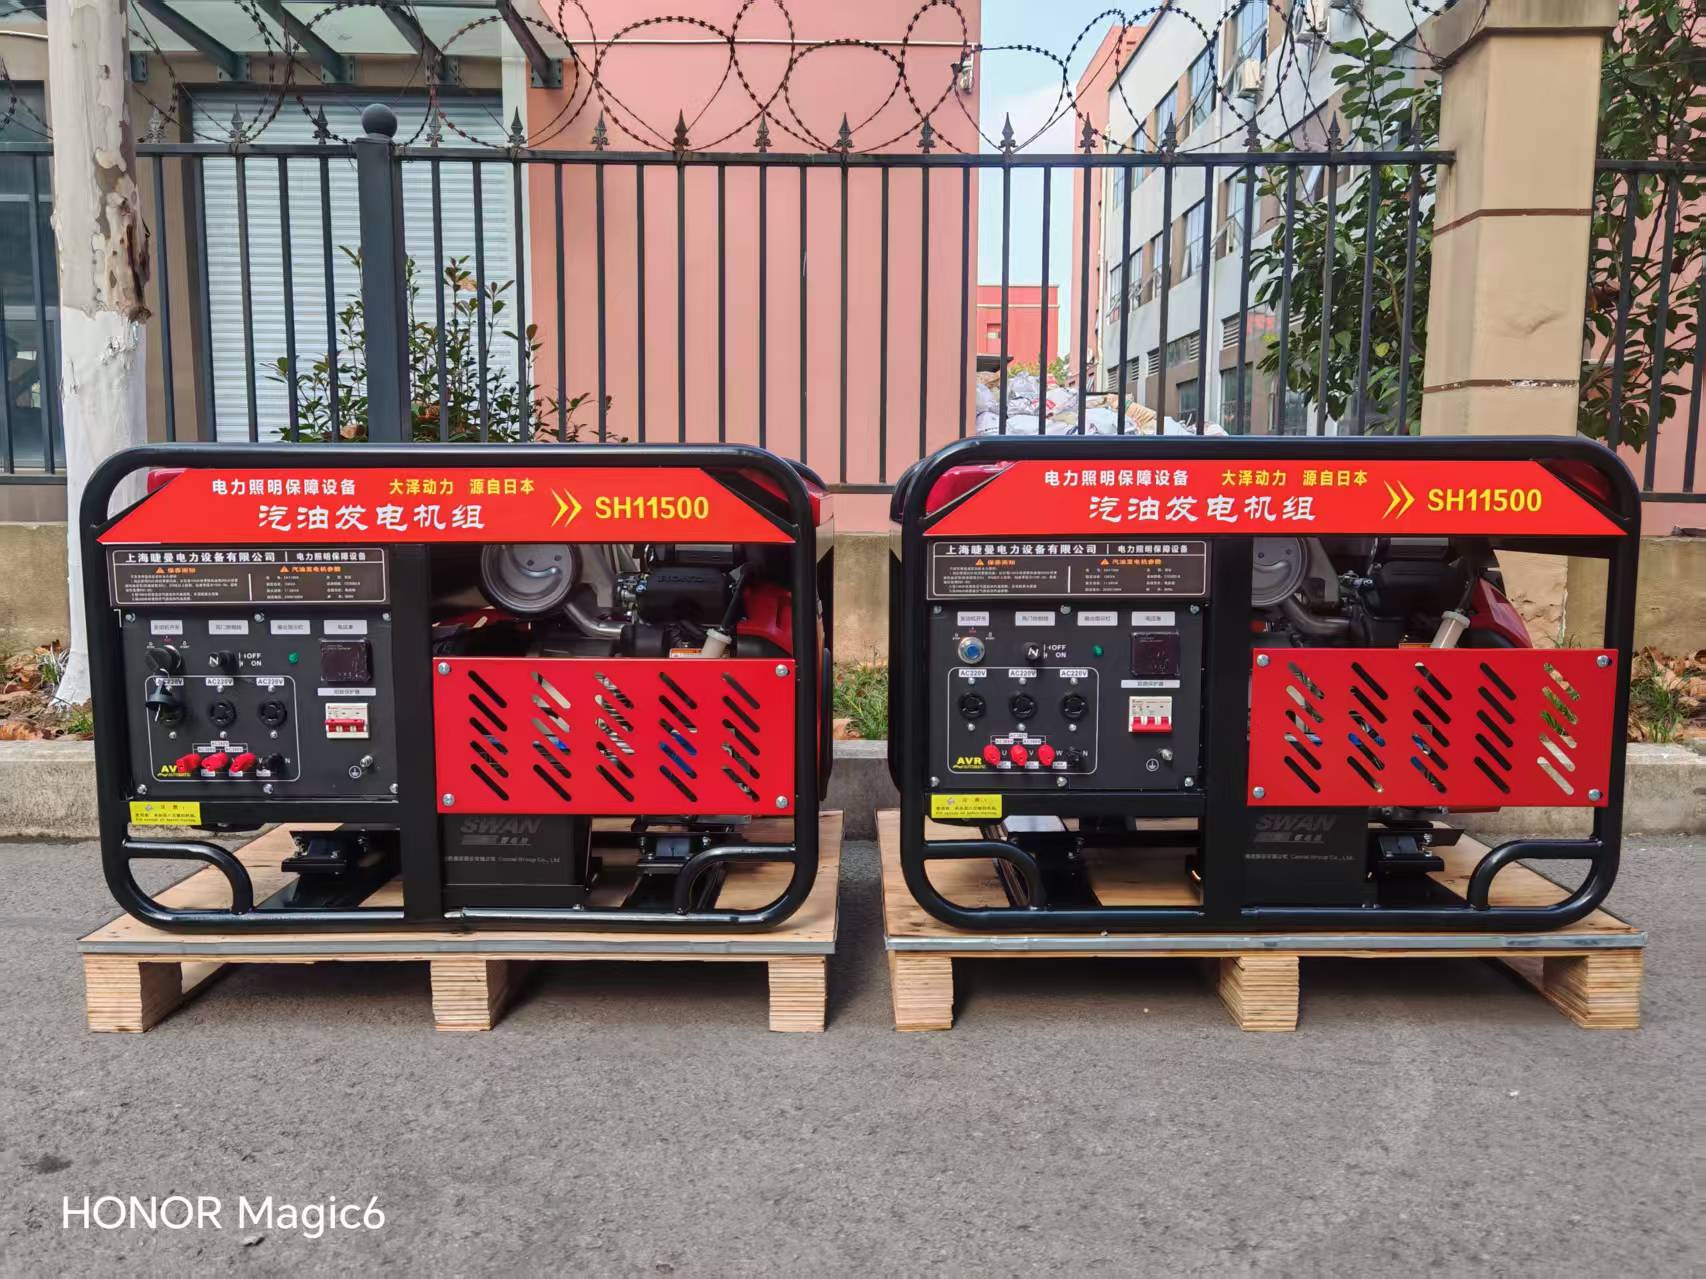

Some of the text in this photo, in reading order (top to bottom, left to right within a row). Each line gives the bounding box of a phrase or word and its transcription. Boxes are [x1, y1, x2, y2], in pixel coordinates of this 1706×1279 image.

[213, 478, 356, 496] 电力照明保障设备
[389, 477, 535, 495] 大泽动力 源自日本
[1044, 469, 1189, 487] 电力照明保障设备
[1221, 469, 1368, 487] 大泽动力 源自日本
[595, 496, 709, 520] SH11500
[1089, 494, 1316, 523] 汽油发电机组
[1427, 488, 1542, 512] SH11500
[258, 503, 485, 532] 汽油发电机组
[247, 652, 261, 660] OFF
[957, 757, 982, 765] AVR
[461, 816, 541, 834] SWAN
[1256, 815, 1336, 831] SWAN
